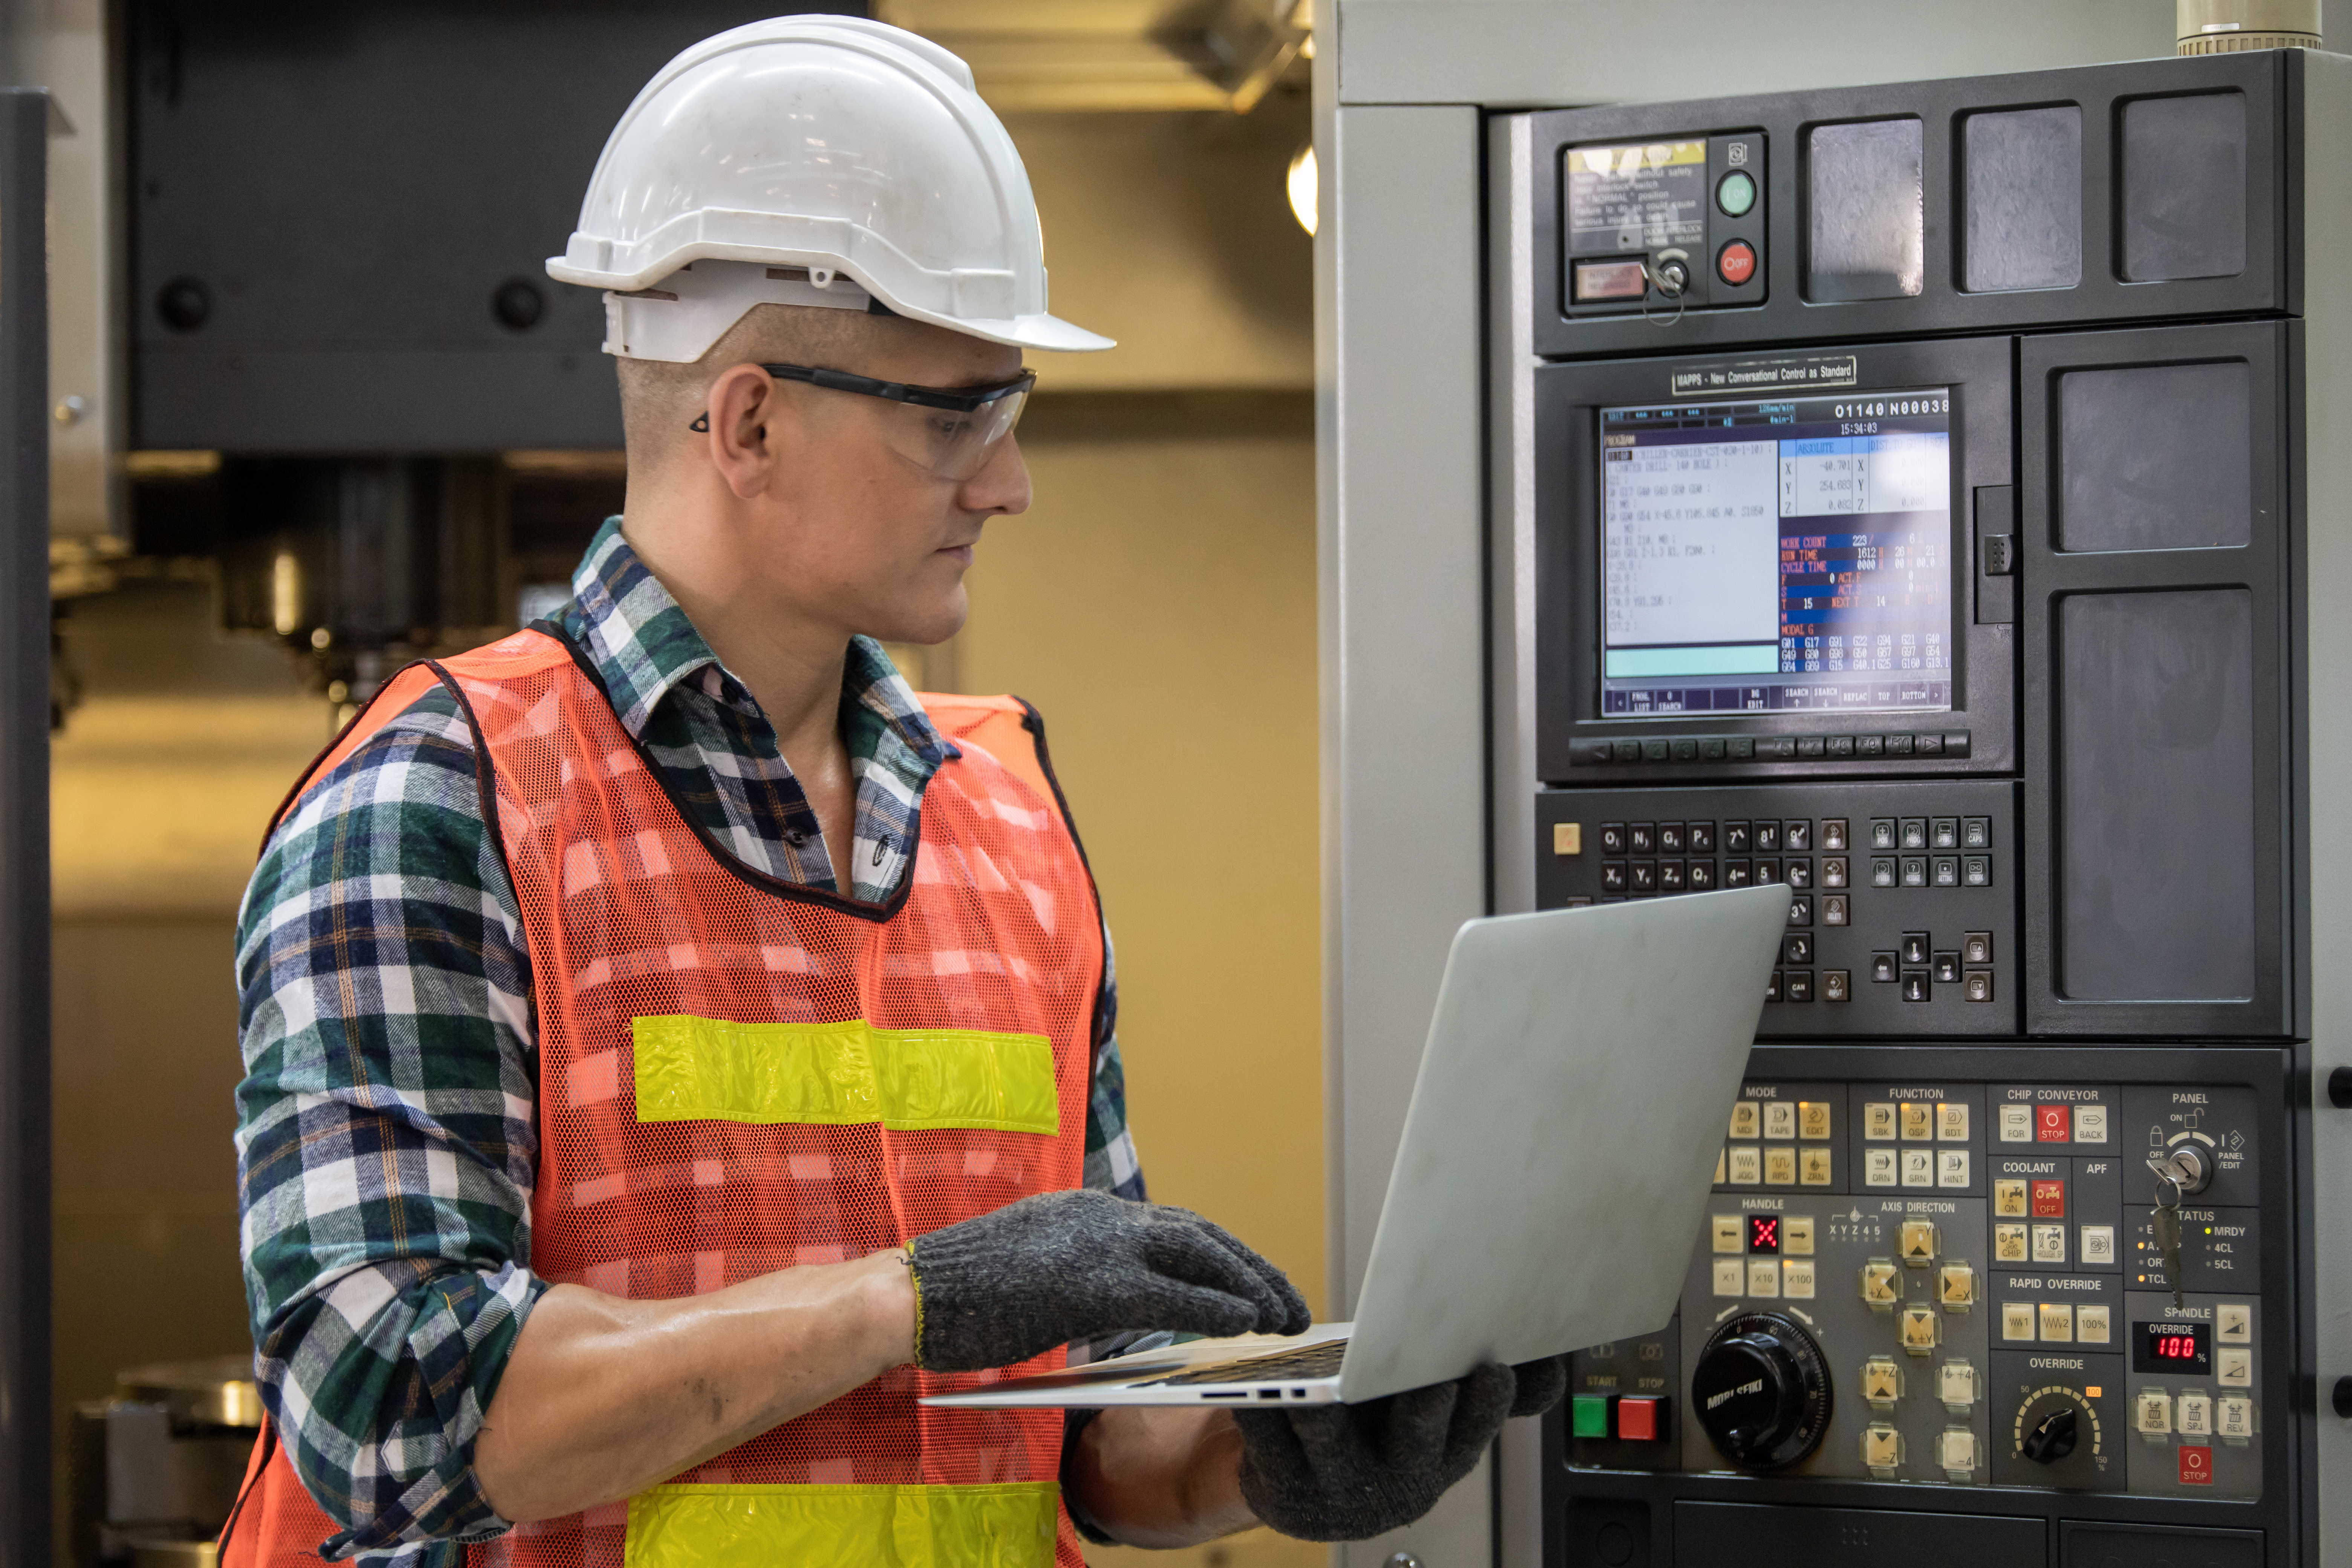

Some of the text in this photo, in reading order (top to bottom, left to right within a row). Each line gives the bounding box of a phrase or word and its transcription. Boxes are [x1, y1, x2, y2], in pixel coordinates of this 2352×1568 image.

[1668, 167, 1692, 178] safety
[1638, 191, 1669, 201] position
[1677, 364, 1851, 387] MAPPS New Conversational Control as Standard
[1890, 399, 1949, 415] N00038
[1841, 422, 1878, 436] 15:34:03
[1798, 442, 1834, 453] ABSOLUTE
[1785, 462, 1791, 475] X
[1857, 459, 1864, 471] X
[1785, 481, 1791, 494] Y
[1858, 479, 1864, 490] Y
[1785, 502, 1791, 514] Z
[1858, 498, 1864, 511] Z
[1781, 536, 1827, 549] WORK COUNT
[1781, 545, 1934, 562] RUN TIME 1612 26 21
[1781, 561, 1804, 573] CYCLE
[1808, 560, 1827, 573] TIME
[1857, 559, 1876, 571] 0000
[1895, 558, 1904, 569] 00
[1804, 596, 1885, 609] 15 NEXT 14
[1781, 625, 1804, 635] MODAL
[1805, 636, 1819, 648] G17
[1877, 634, 1891, 646] G94
[1902, 634, 1915, 646] G21
[1926, 633, 1940, 645] G40
[1902, 645, 1916, 657] G97
[1926, 645, 1940, 657] G54
[1829, 659, 1843, 671] G15
[1902, 657, 1920, 669] G160
[1926, 657, 1949, 668] G13.1
[1785, 688, 1808, 698] SEARCH
[1814, 687, 1838, 697] SEARCH
[1844, 691, 1867, 701] REPLAC
[1879, 691, 1890, 701] TOP
[1902, 691, 1926, 700] BOTTOM
[1761, 830, 1767, 843] 8
[1790, 830, 1797, 842] 9
[1730, 869, 1736, 881] 4
[1761, 867, 1767, 879] 5
[1791, 868, 1798, 879] 6
[1792, 905, 1798, 917] 3
[1746, 1087, 1776, 1097] MODE
[1890, 1088, 1943, 1099] FUNCTION
[2007, 1090, 2098, 1100] CHIP CONVEYOR
[2173, 1093, 2209, 1104] PANEL
[1770, 1126, 1790, 1135] TAPE
[1806, 1127, 1824, 1135] EDIT
[2003, 1162, 2055, 1173] COOLANT
[2087, 1164, 2107, 1174] APF
[1772, 1172, 1788, 1180] RPD
[1808, 1173, 1824, 1181] ZRN
[1743, 1199, 1784, 1210] HANDLE
[1881, 1202, 1955, 1213] AXIS DIRECTION
[2177, 1211, 2214, 1221] TATUS
[1755, 1219, 1776, 1246] X
[1830, 1225, 1880, 1235] X Y Z 4 5
[2214, 1227, 2245, 1236] MRDY
[2214, 1243, 2233, 1253] 4CL
[2215, 1260, 2234, 1269] 5CL
[2010, 1278, 2101, 1290] RAPID OVERRIDE
[2148, 1274, 2167, 1284] TCL
[2165, 1307, 2211, 1318] SPINDLE
[2082, 1320, 2106, 1329] 100%
[2149, 1324, 2193, 1334] OVERRIDE
[2159, 1337, 2194, 1357] 100
[2197, 1353, 2206, 1362] %
[2030, 1358, 2083, 1369] OVERRIDE
[1586, 1376, 1617, 1387] START
[1638, 1378, 1664, 1388] STOP
[2145, 1420, 2164, 1429] NOR
[2227, 1424, 2244, 1432] REV
[2184, 1472, 2207, 1480] STOP
